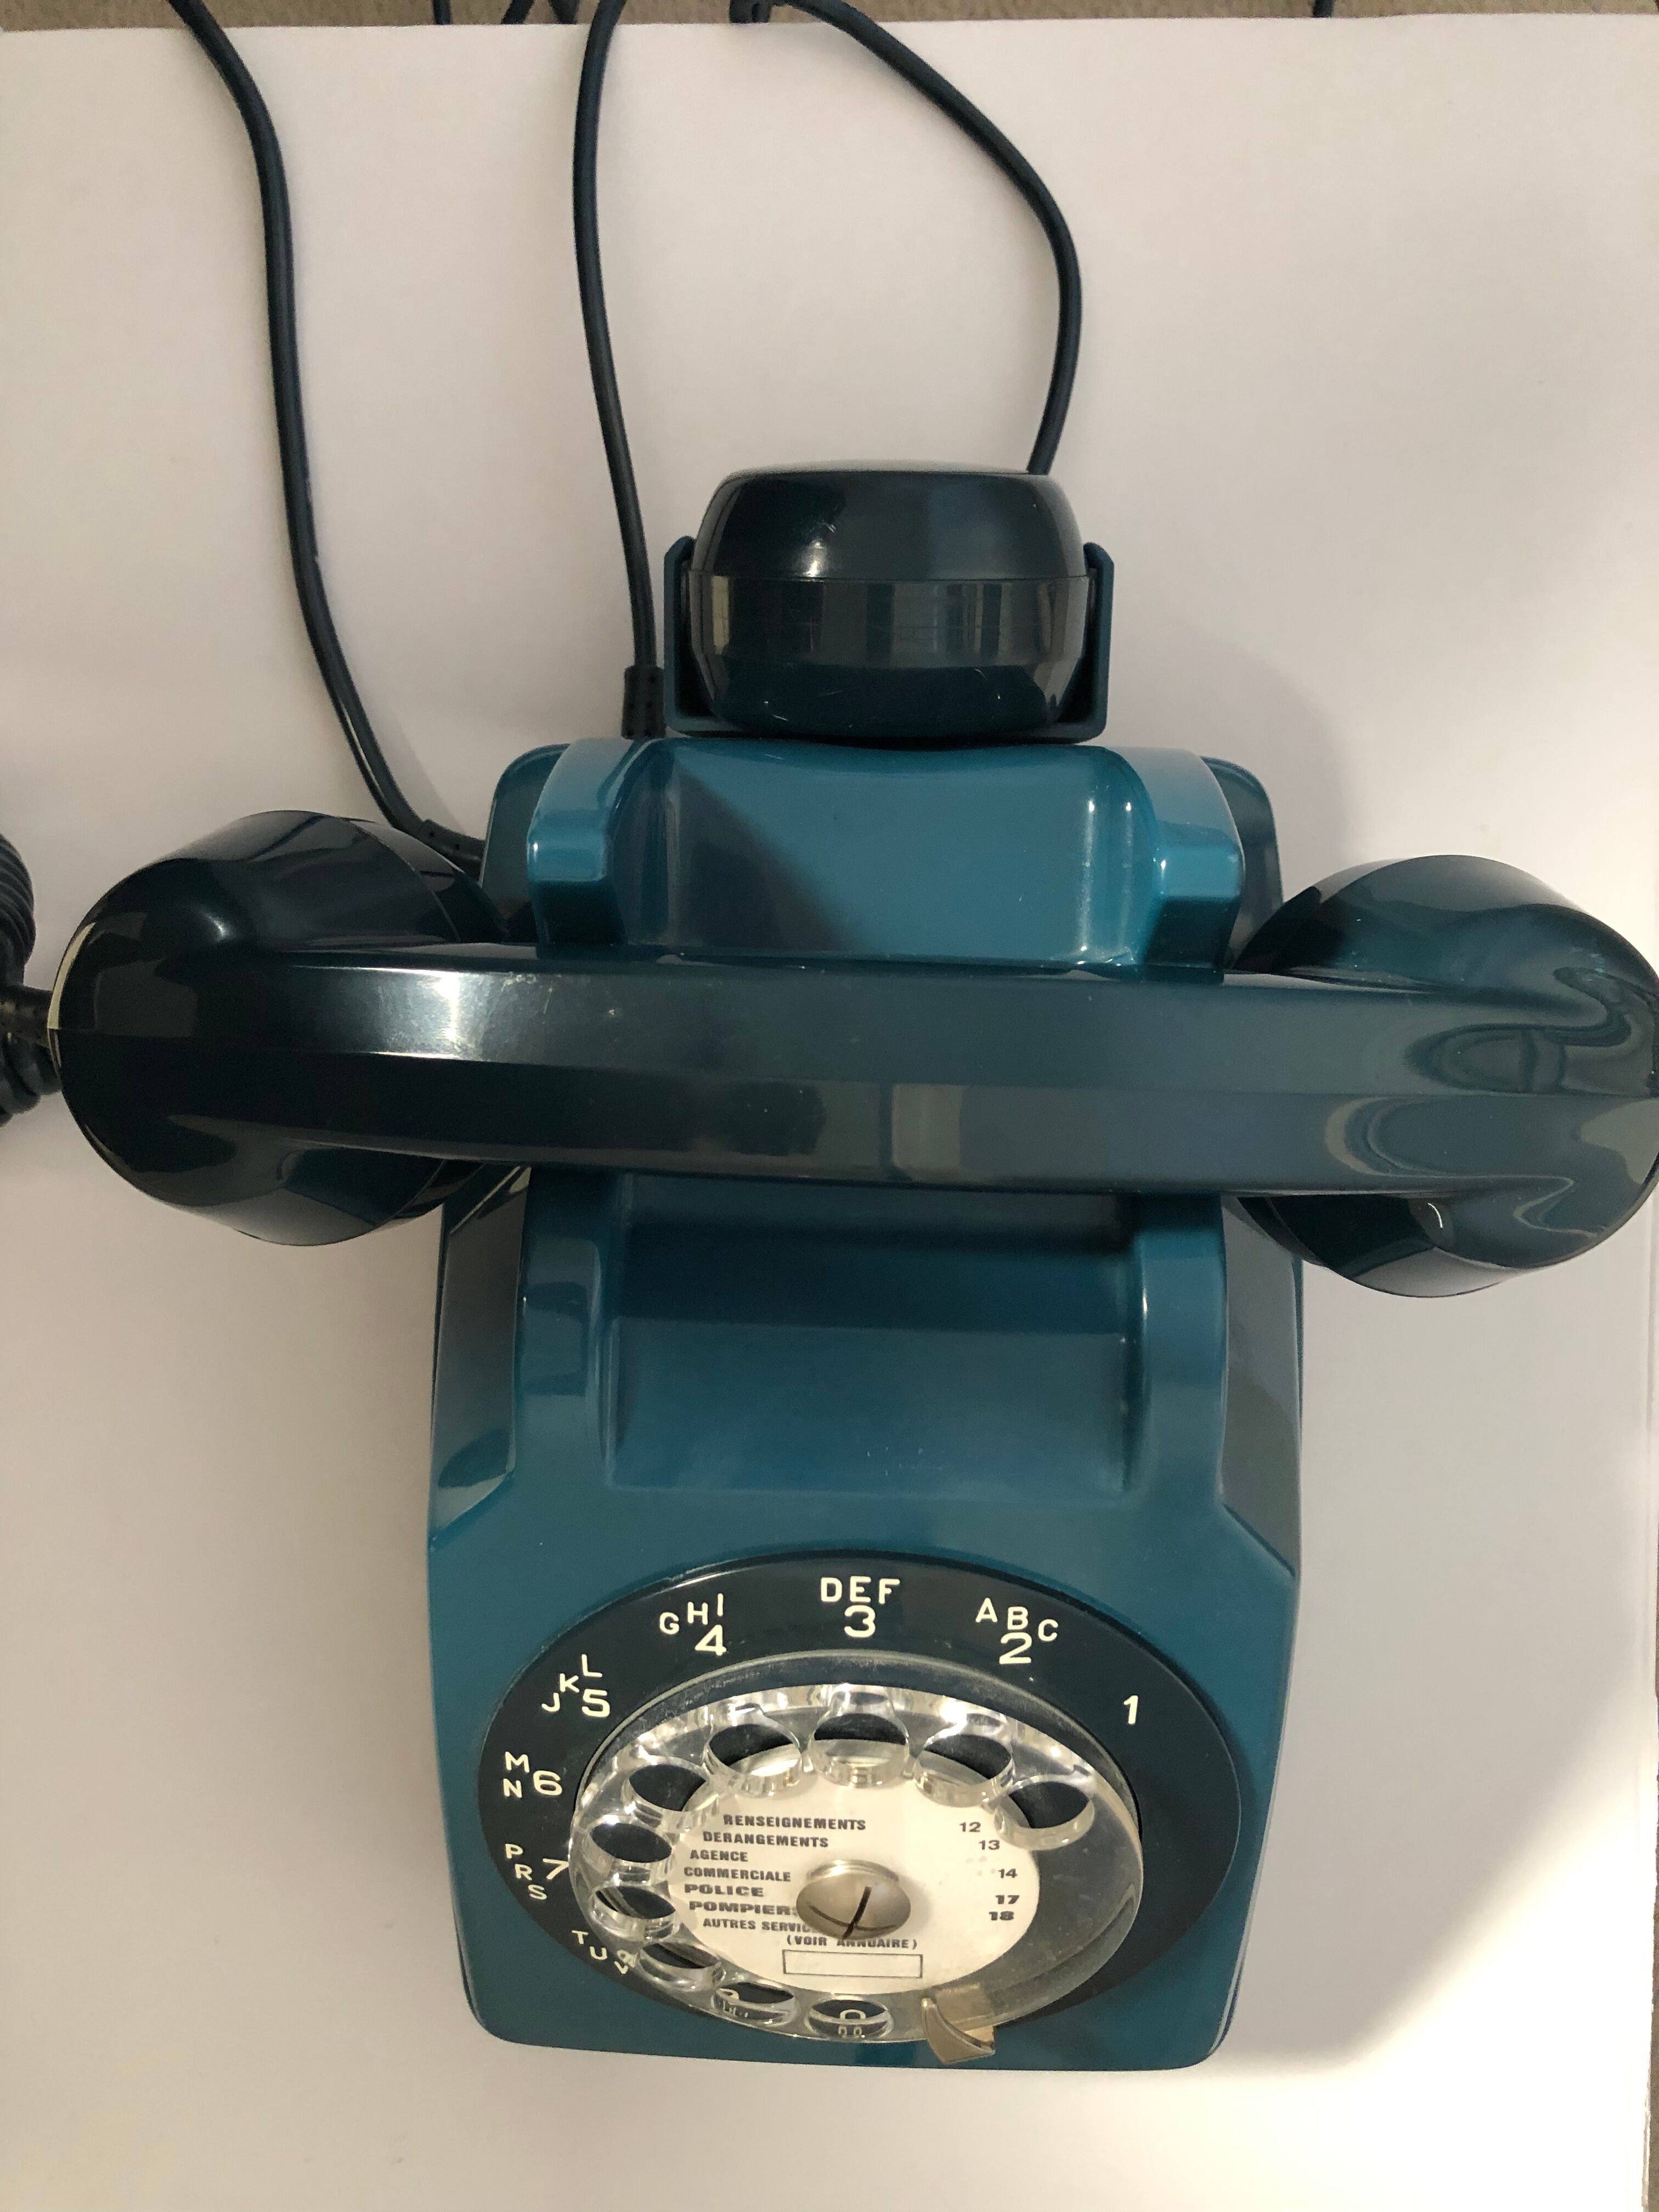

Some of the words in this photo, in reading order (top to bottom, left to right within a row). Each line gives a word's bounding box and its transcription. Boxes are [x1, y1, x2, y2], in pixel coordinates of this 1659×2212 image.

[820, 1576, 900, 1605] DEF
[658, 1593, 725, 1635] GHI
[844, 1605, 876, 1638] 3
[975, 1598, 1059, 1642] ABC
[694, 1624, 727, 1656] 4
[999, 1632, 1032, 1664] 2
[582, 1688, 611, 1718] 5
[1123, 1695, 1138, 1724] 1
[533, 1770, 562, 1796] 6
[723, 1814, 866, 1830] RENSEIGNEMENTS
[959, 1821, 981, 1832] 12
[703, 1831, 829, 1848] DERANGEMENTS
[979, 1839, 1000, 1850] 13
[690, 1849, 748, 1863] AGENCE
[542, 1858, 569, 1880] 7
[684, 1866, 791, 1882] COMMERCIALE
[997, 1868, 1018, 1878] 14
[684, 1883, 764, 1898] POLICE
[995, 1894, 1020, 1904] 17
[989, 1911, 1015, 1921] 18
[703, 1917, 756, 1930] AUTRES
[761, 1921, 813, 1933] SERVIC
